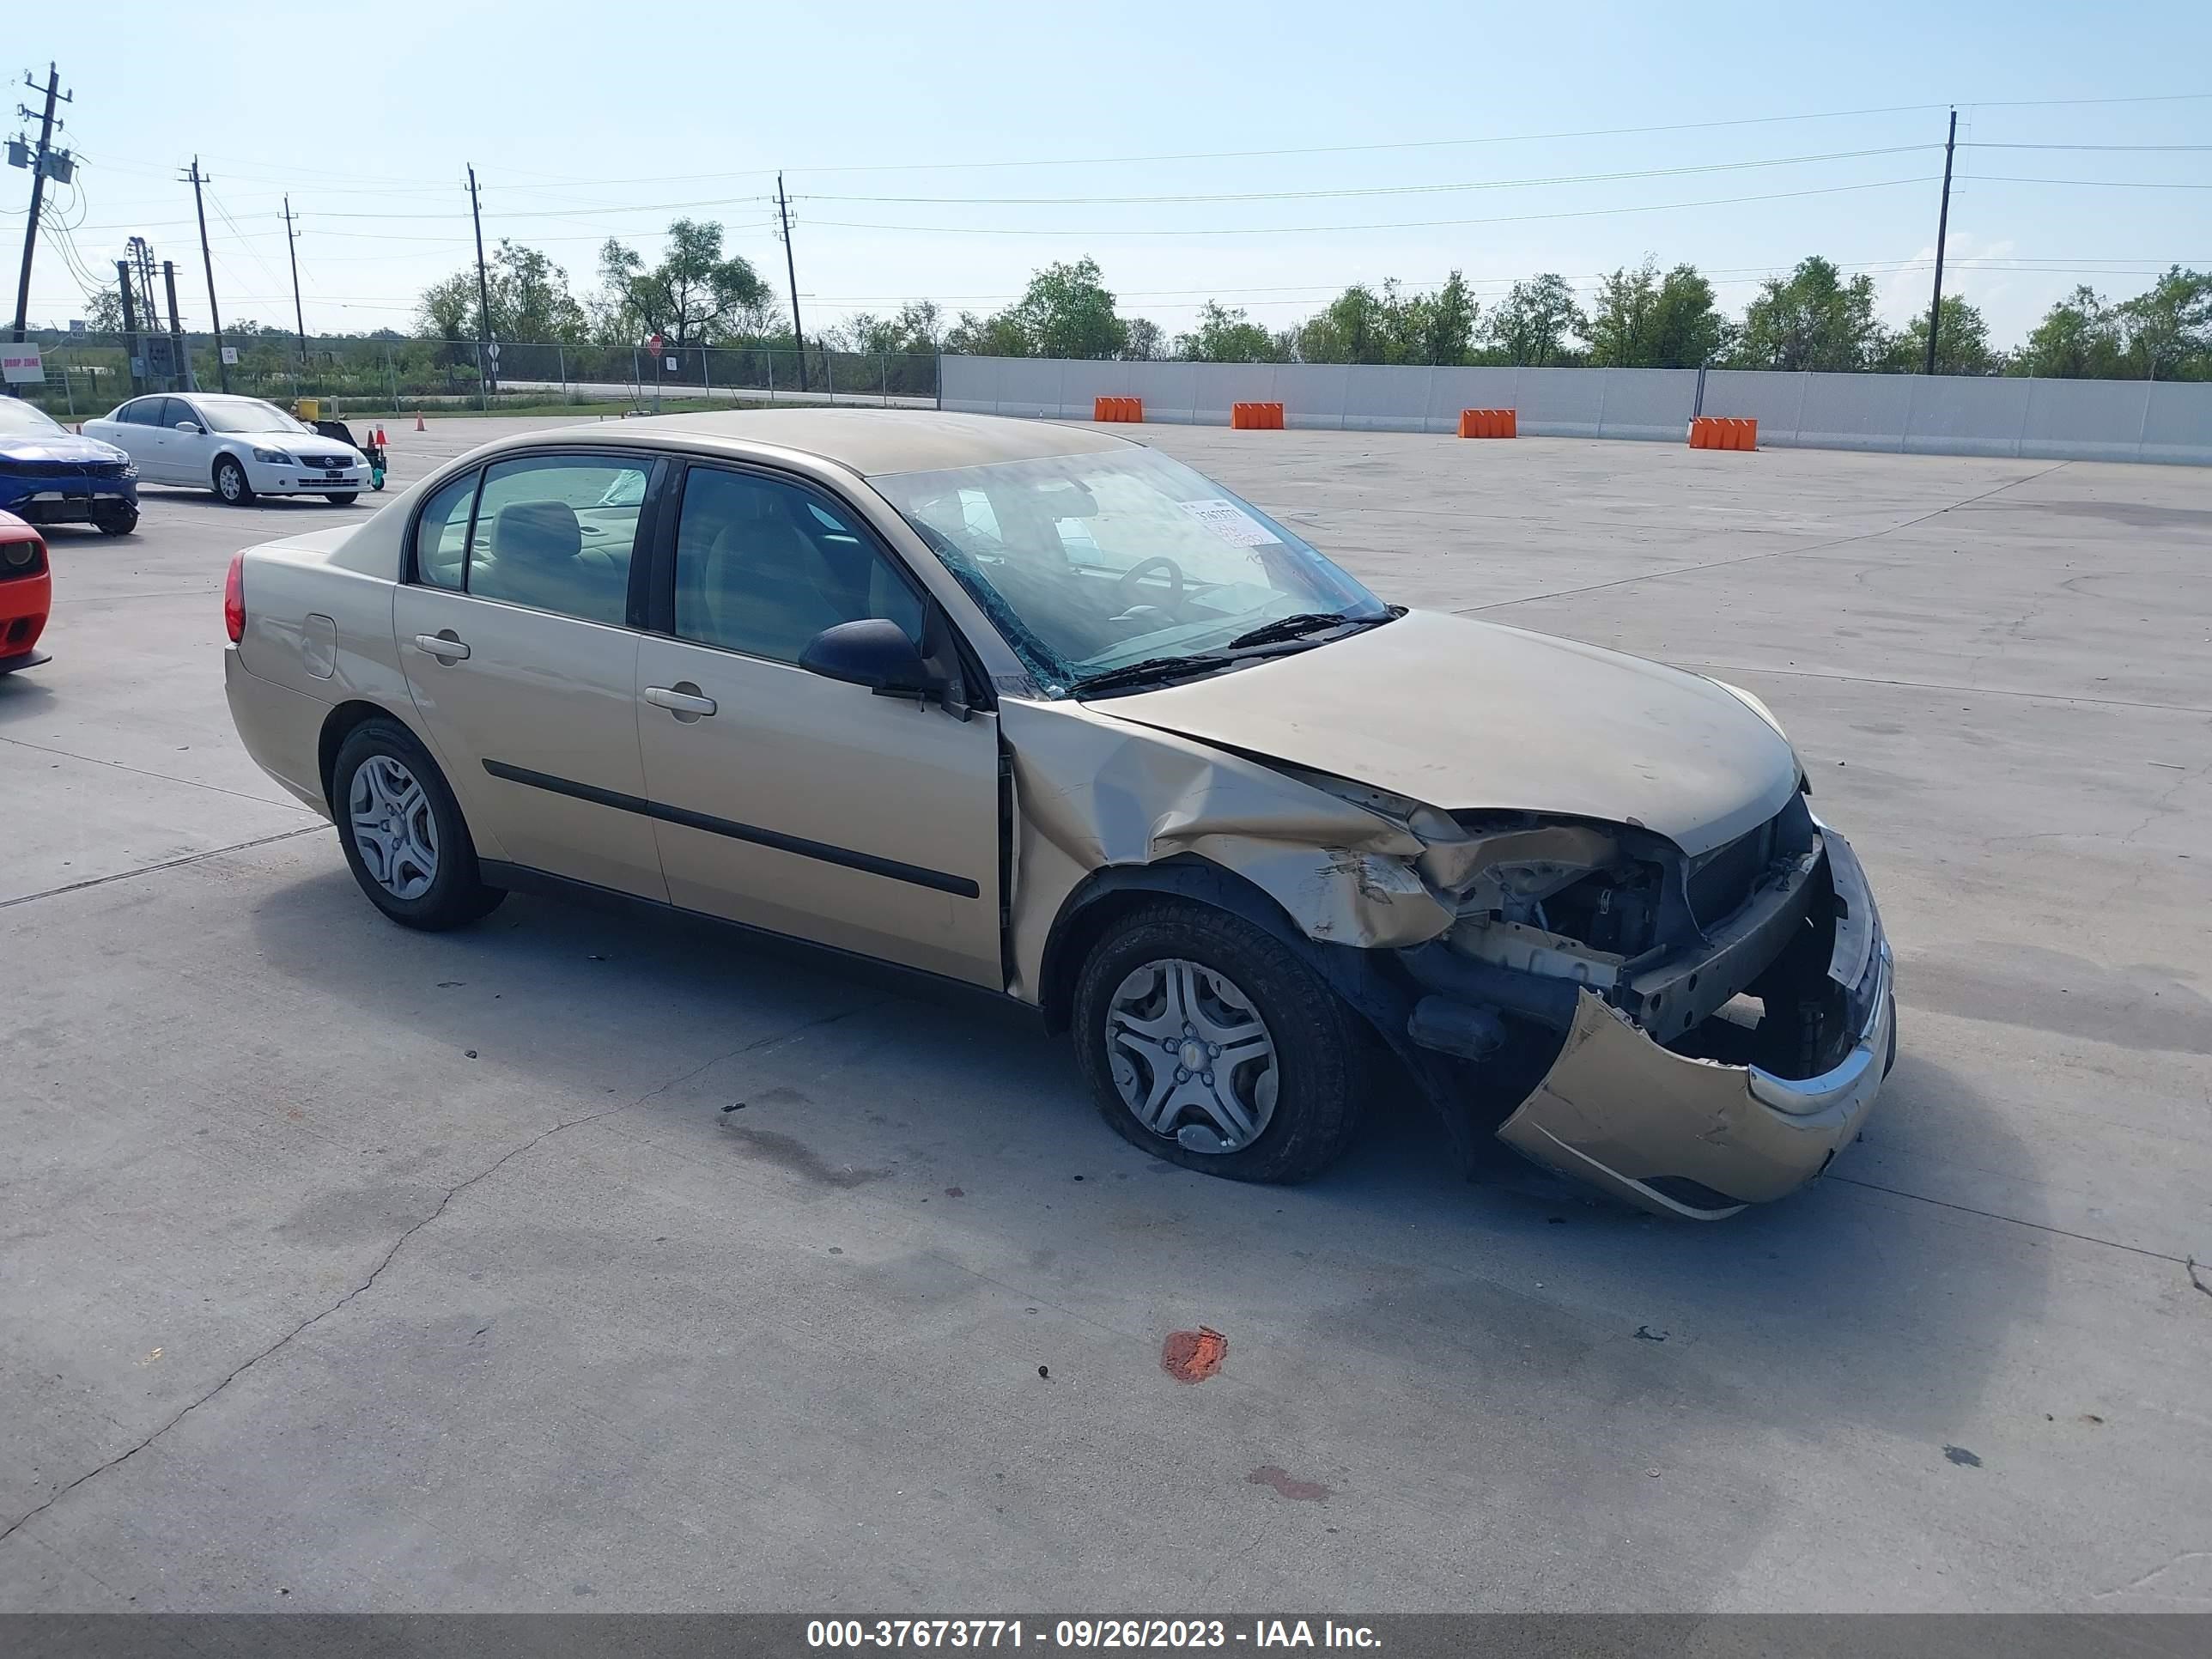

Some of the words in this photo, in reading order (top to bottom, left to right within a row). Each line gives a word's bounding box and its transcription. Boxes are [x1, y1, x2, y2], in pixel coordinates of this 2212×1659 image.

[3, 358, 21, 368] DROP
[24, 358, 40, 368] ZONE
[1194, 508, 1243, 521] 37673771
